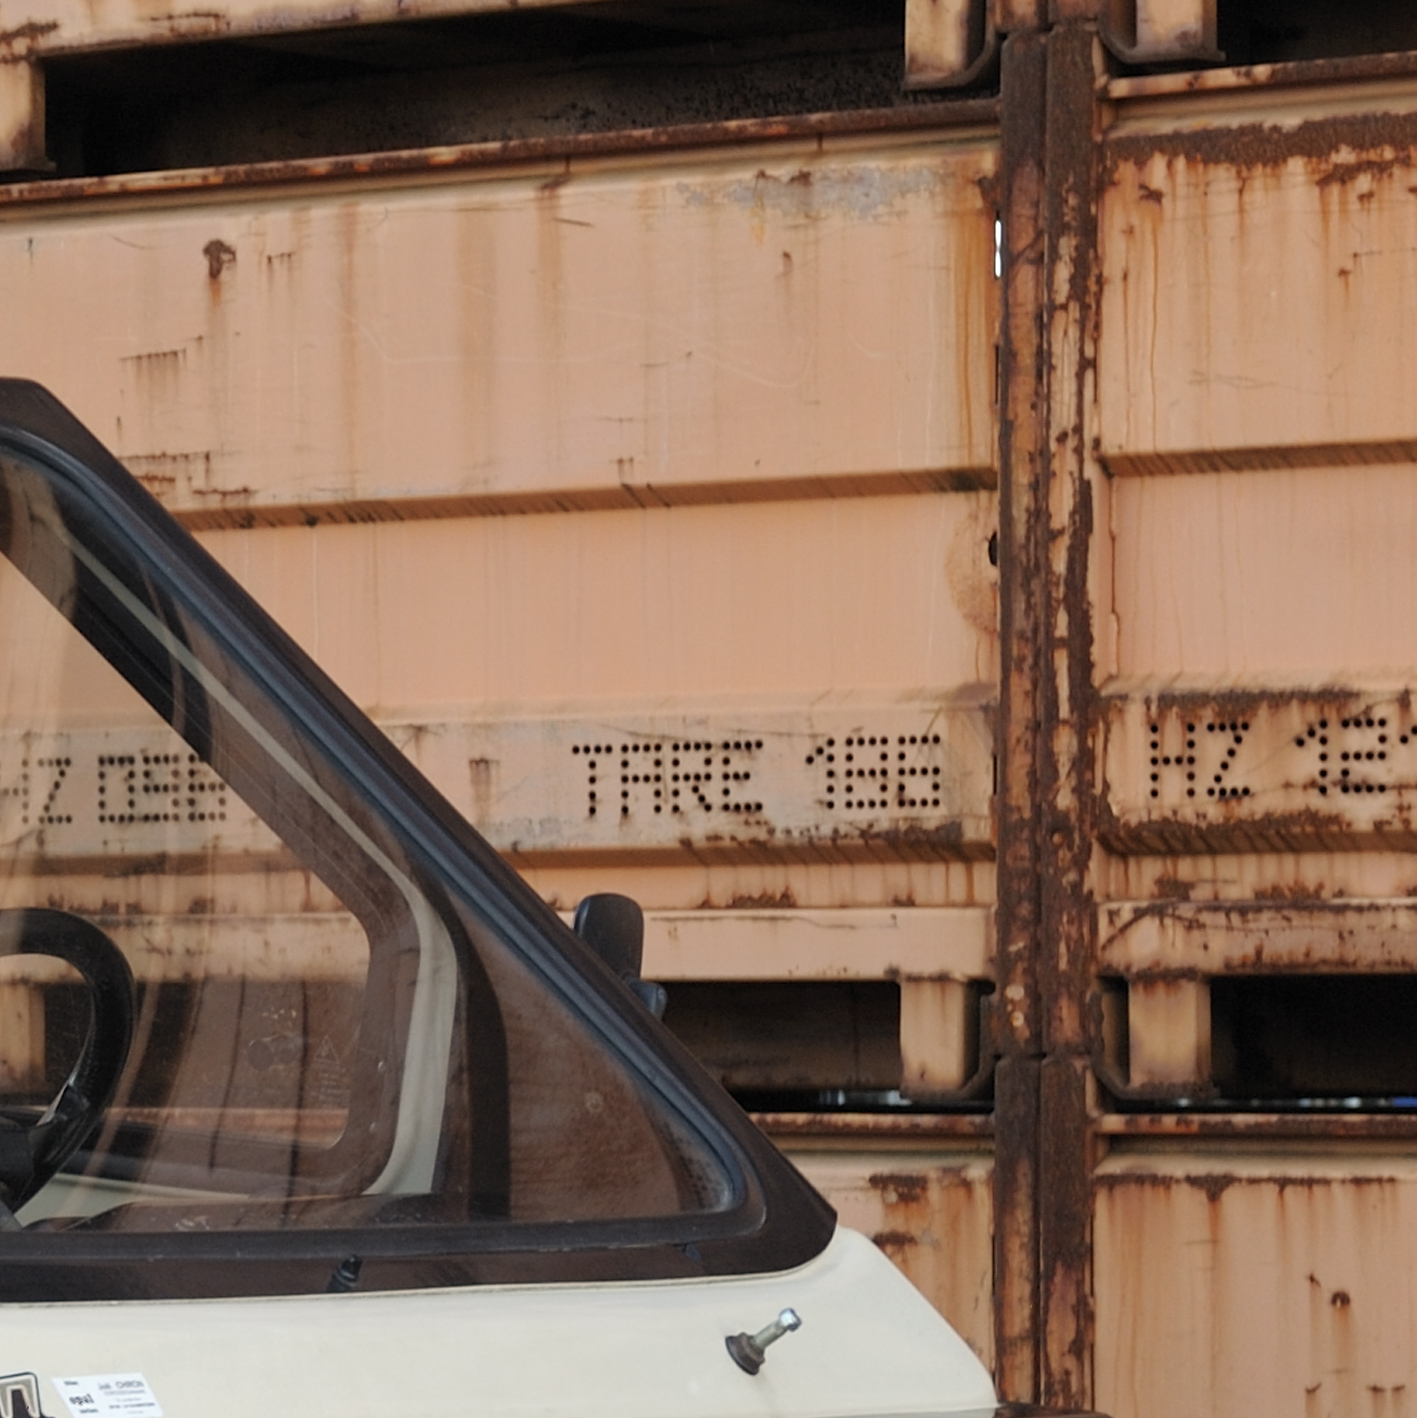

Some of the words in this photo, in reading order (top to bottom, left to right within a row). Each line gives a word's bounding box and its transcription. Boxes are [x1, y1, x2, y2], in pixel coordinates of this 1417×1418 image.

[570, 740, 764, 815] TARE
[803, 734, 941, 809] 186
[1150, 711, 1251, 798] HZ
